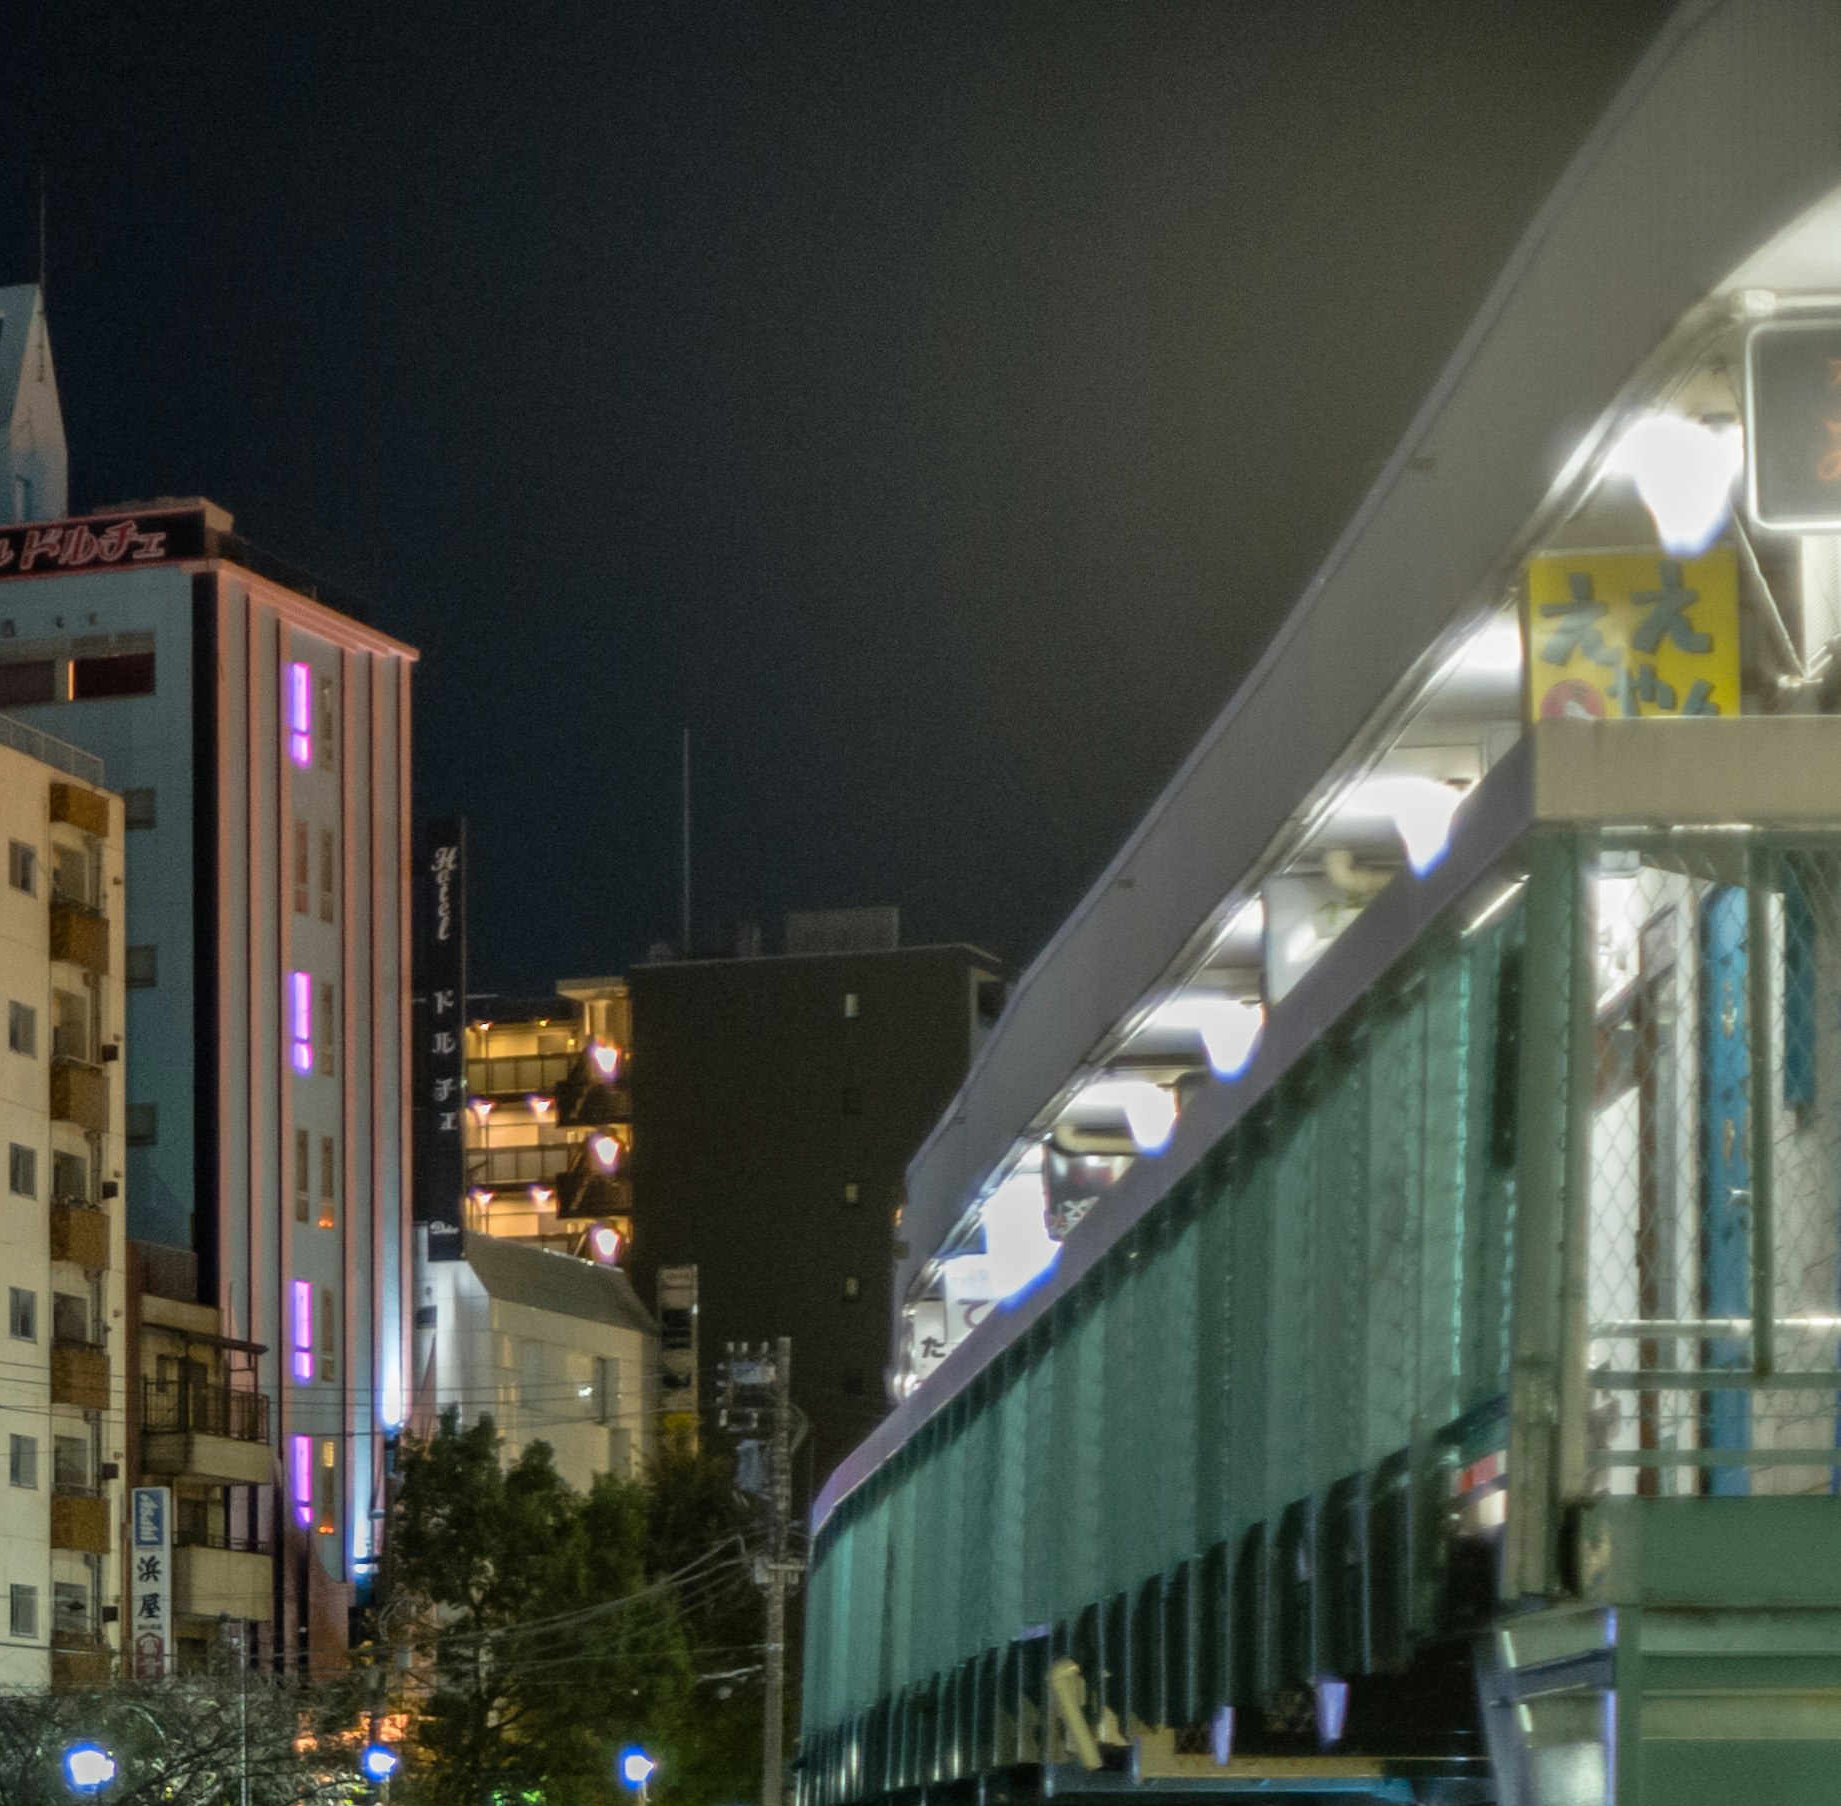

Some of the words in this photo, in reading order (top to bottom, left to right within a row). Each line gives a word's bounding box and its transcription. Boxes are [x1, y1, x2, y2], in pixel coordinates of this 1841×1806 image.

[18, 519, 168, 571] ドルチェ
[429, 845, 459, 941] Hotel
[432, 988, 459, 1132] ドルチェ
[136, 1554, 163, 1620] 浜屋
